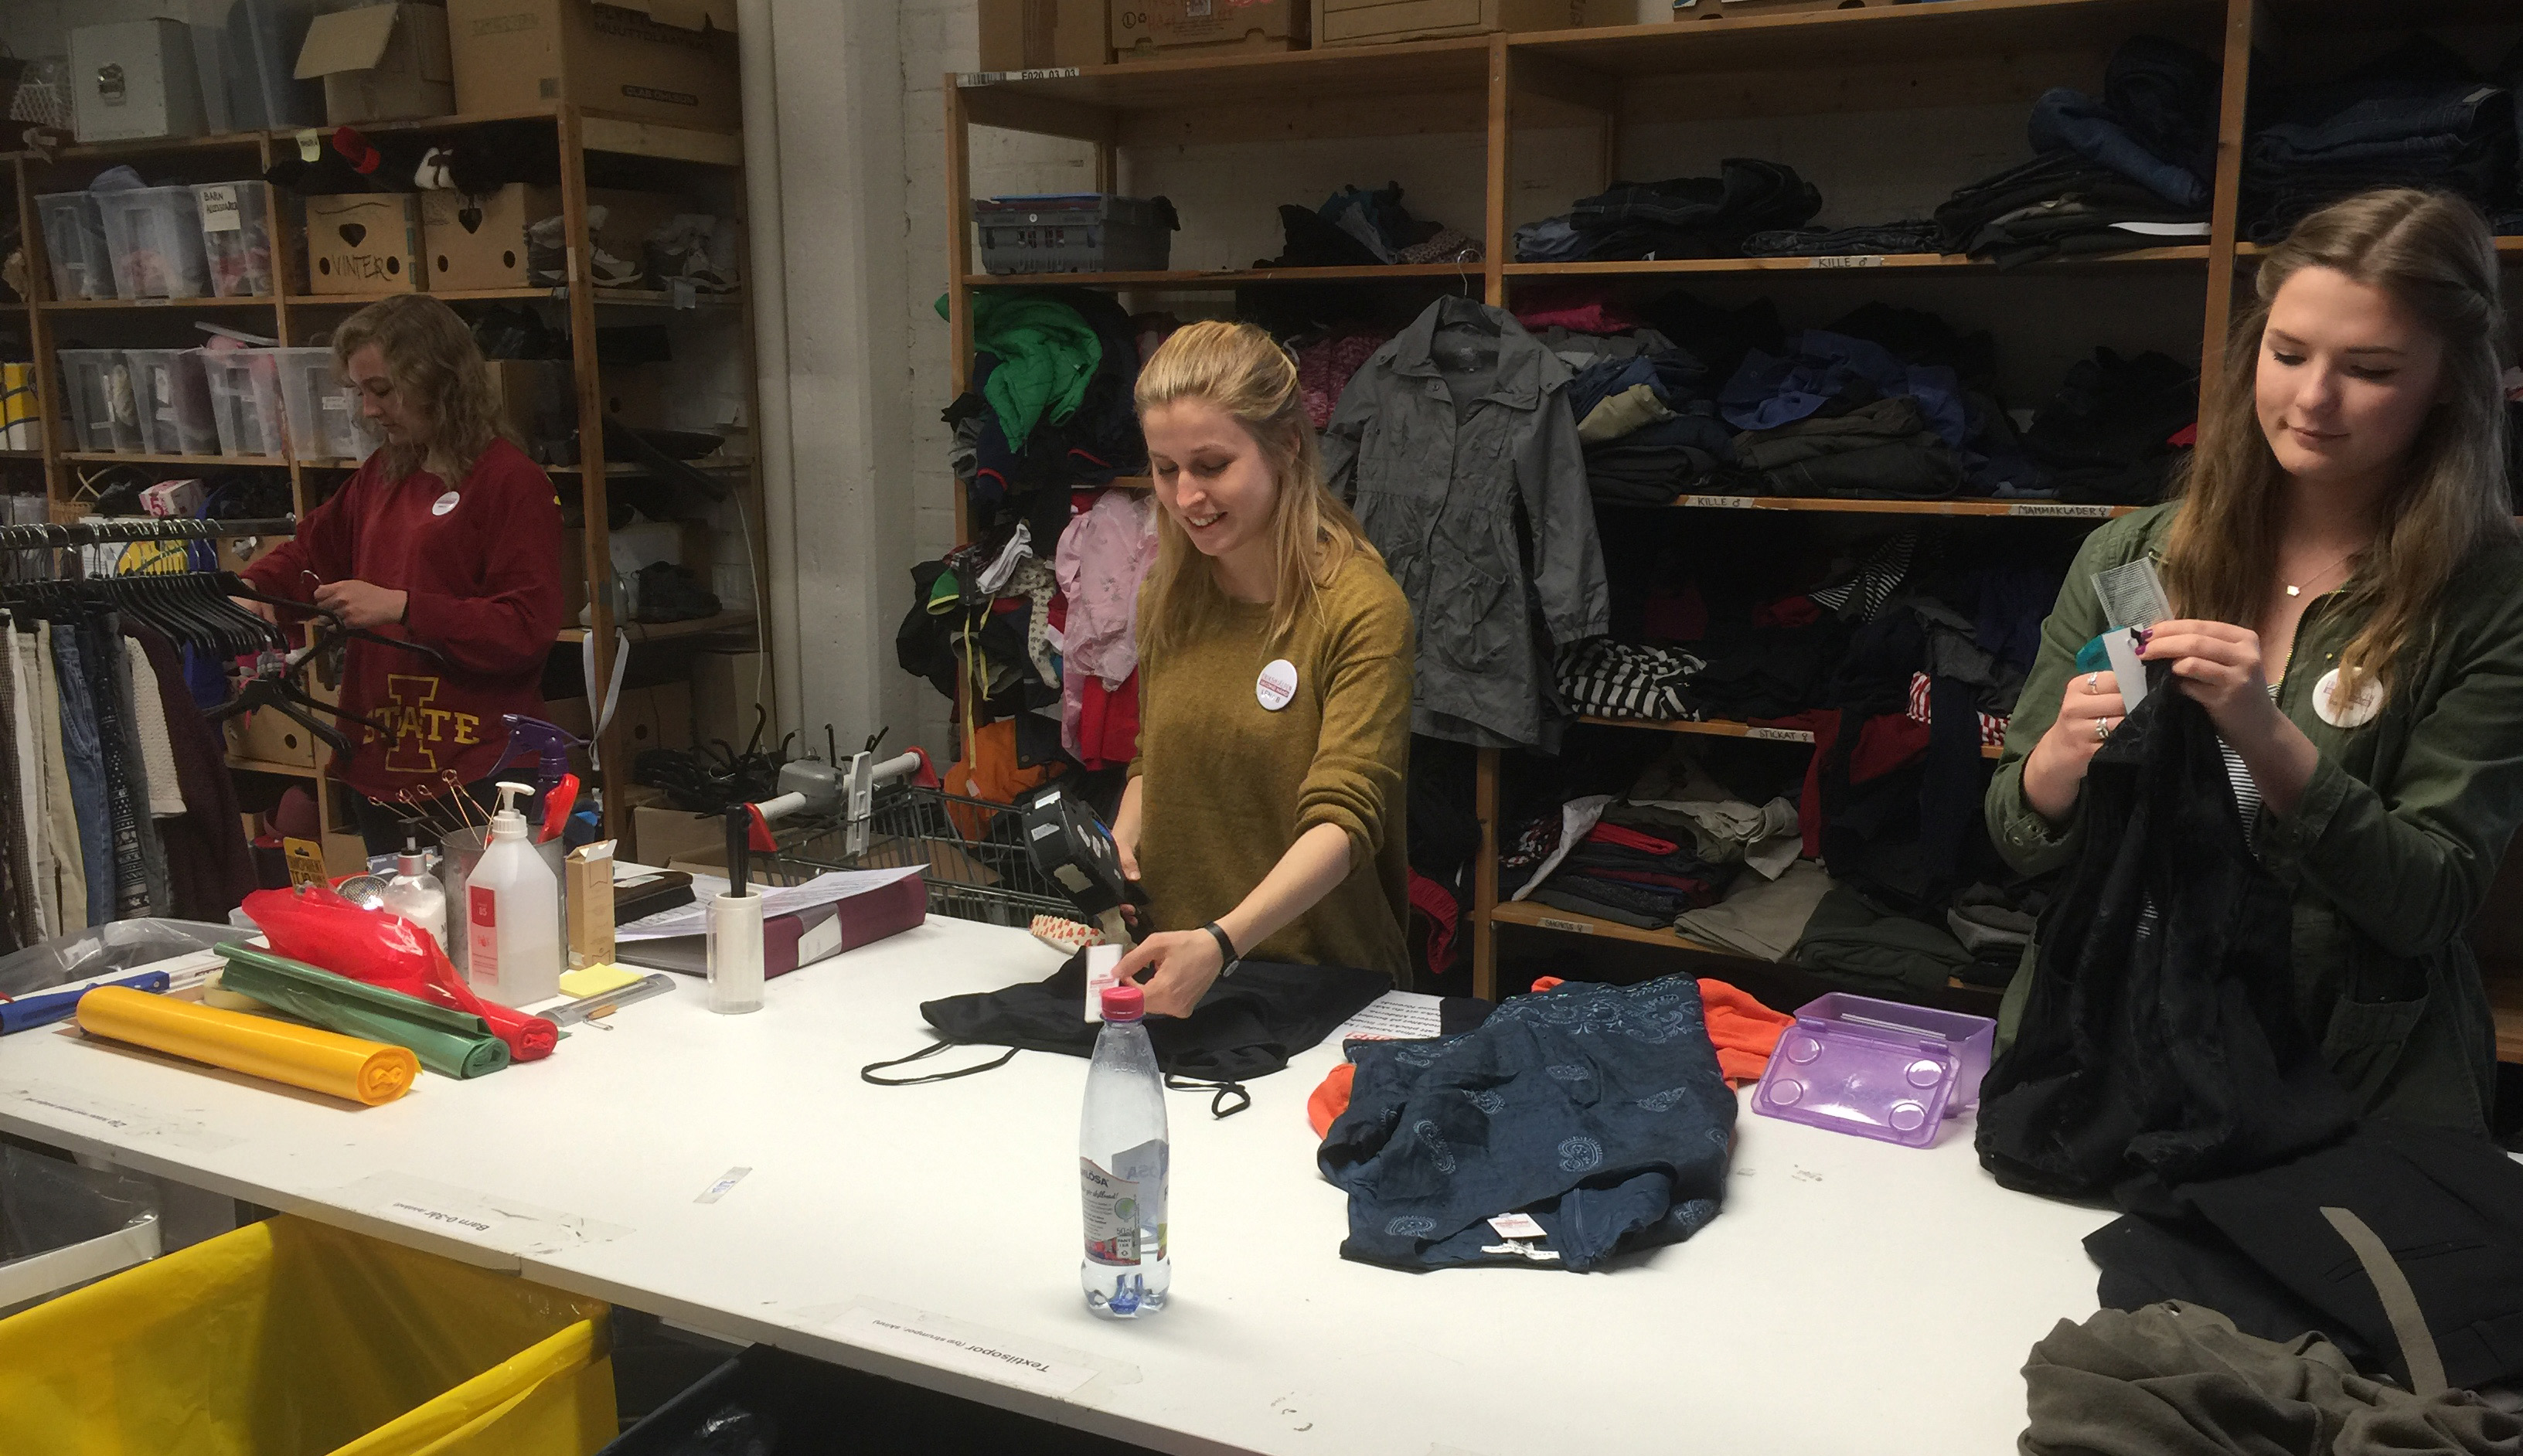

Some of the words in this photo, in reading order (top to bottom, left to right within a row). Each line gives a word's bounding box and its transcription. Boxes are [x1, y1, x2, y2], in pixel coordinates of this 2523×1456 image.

[1049, 70, 1060, 79] 03
[1064, 69, 1077, 78] 03
[203, 190, 224, 202] BARN
[332, 253, 393, 282] VINTER
[1818, 257, 1851, 268] KILLE
[1697, 496, 1727, 507] KILLE
[363, 706, 480, 745] STATE
[1759, 729, 1796, 740] STICKAT
[458, 1219, 489, 1231] Barn
[965, 1344, 1050, 1373] Textilsopor
